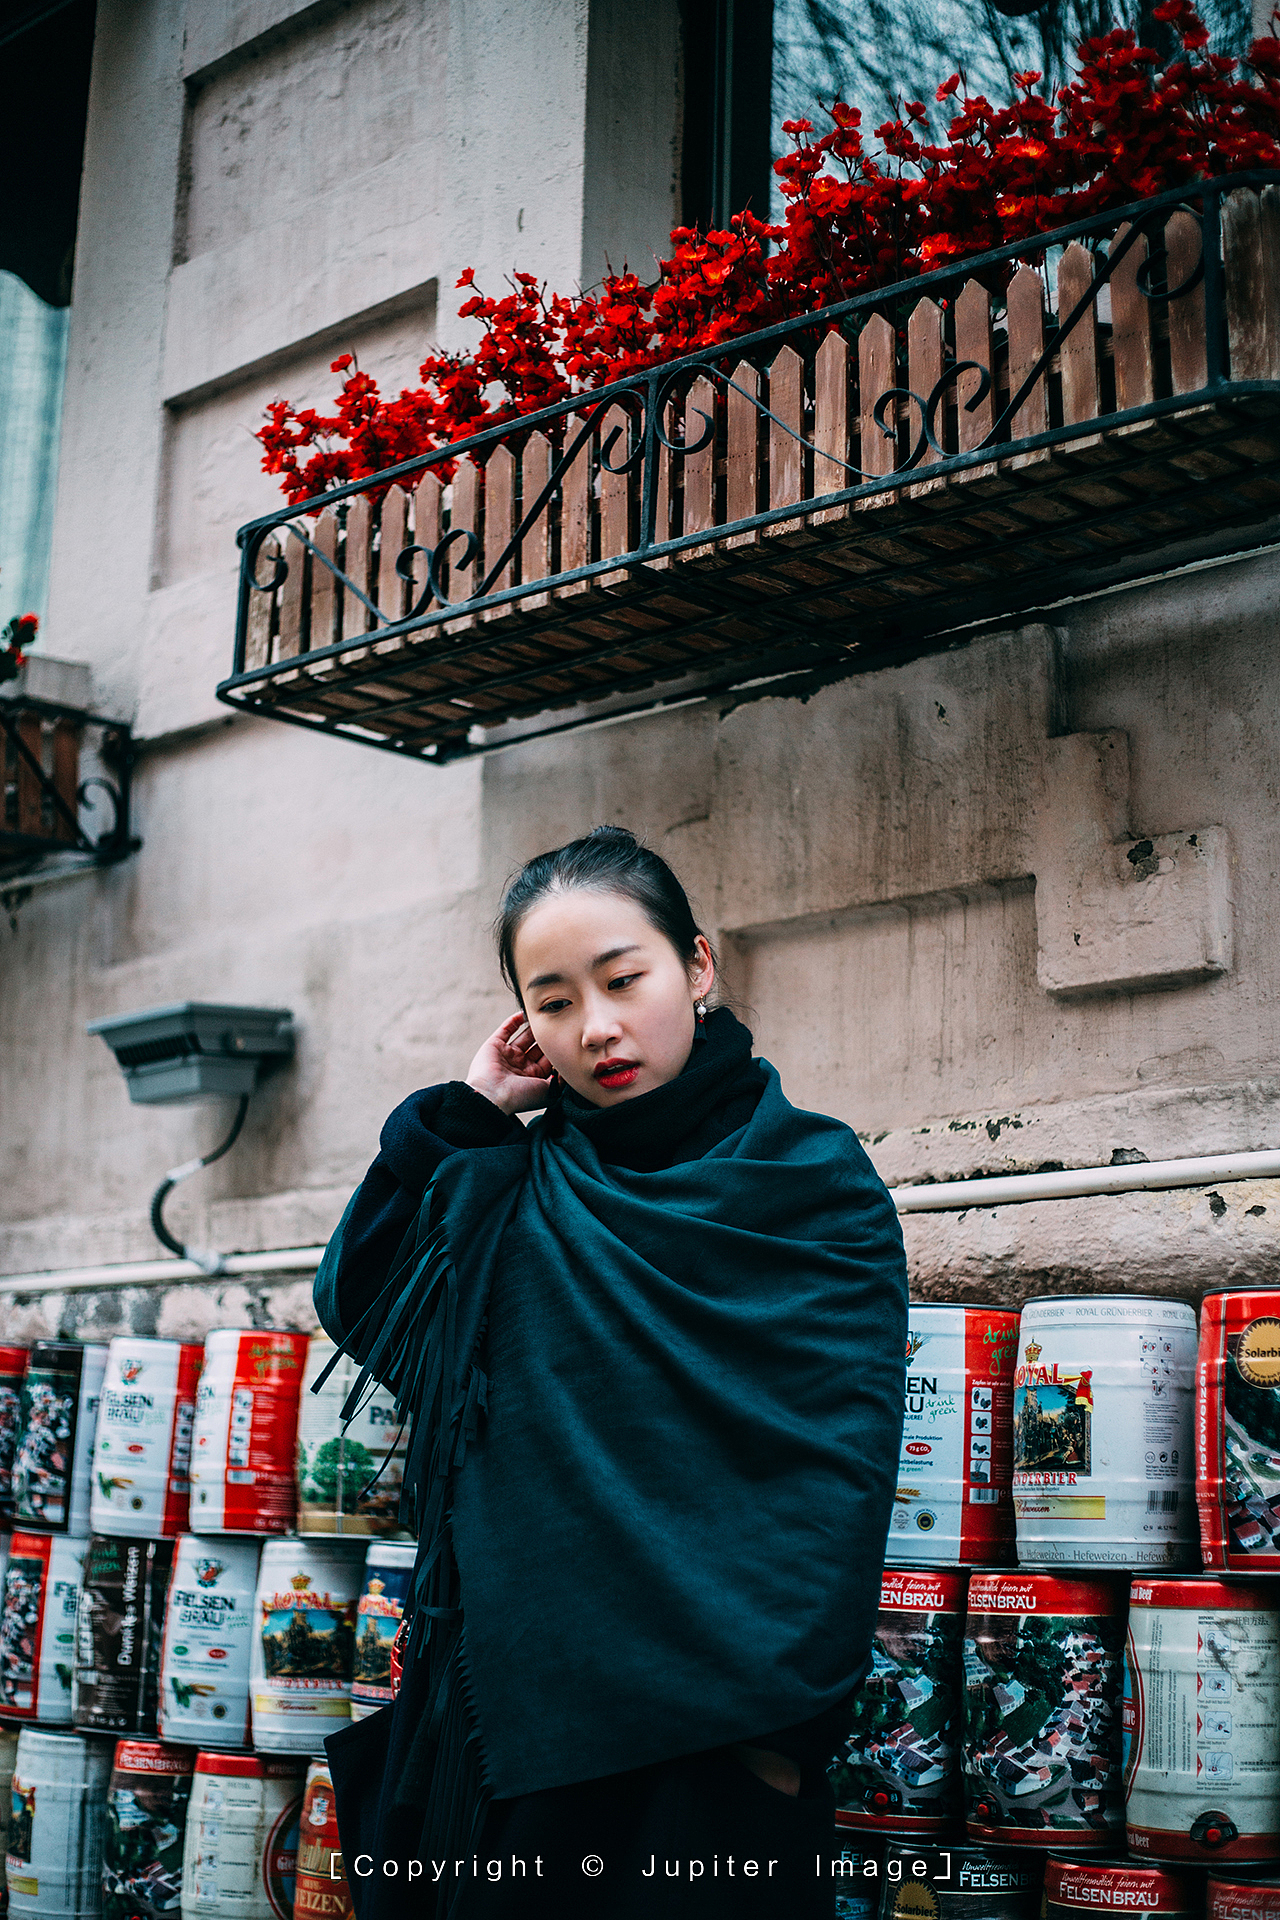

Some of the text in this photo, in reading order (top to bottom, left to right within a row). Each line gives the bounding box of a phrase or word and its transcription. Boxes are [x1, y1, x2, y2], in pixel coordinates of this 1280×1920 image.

[1076, 1308, 1099, 1316] ROYAL
[1100, 1307, 1153, 1318] GRÜNDERBIER
[926, 1395, 955, 1408] drink
[928, 1407, 957, 1424] green
[1073, 1550, 1127, 1561] Hefeweizen
[122, 1546, 141, 1603] Weizen
[905, 1579, 927, 1594] feiern
[927, 1582, 940, 1591] mit
[1000, 1582, 1019, 1596] feiern
[1019, 1584, 1033, 1592] mit
[1138, 1586, 1153, 1600] Beer
[1114, 1877, 1139, 1891] feiern
[1140, 1879, 1155, 1888] mit
[1059, 1881, 1160, 1907] FELSENBRÄU
[896, 1904, 934, 1916] Solarbier
